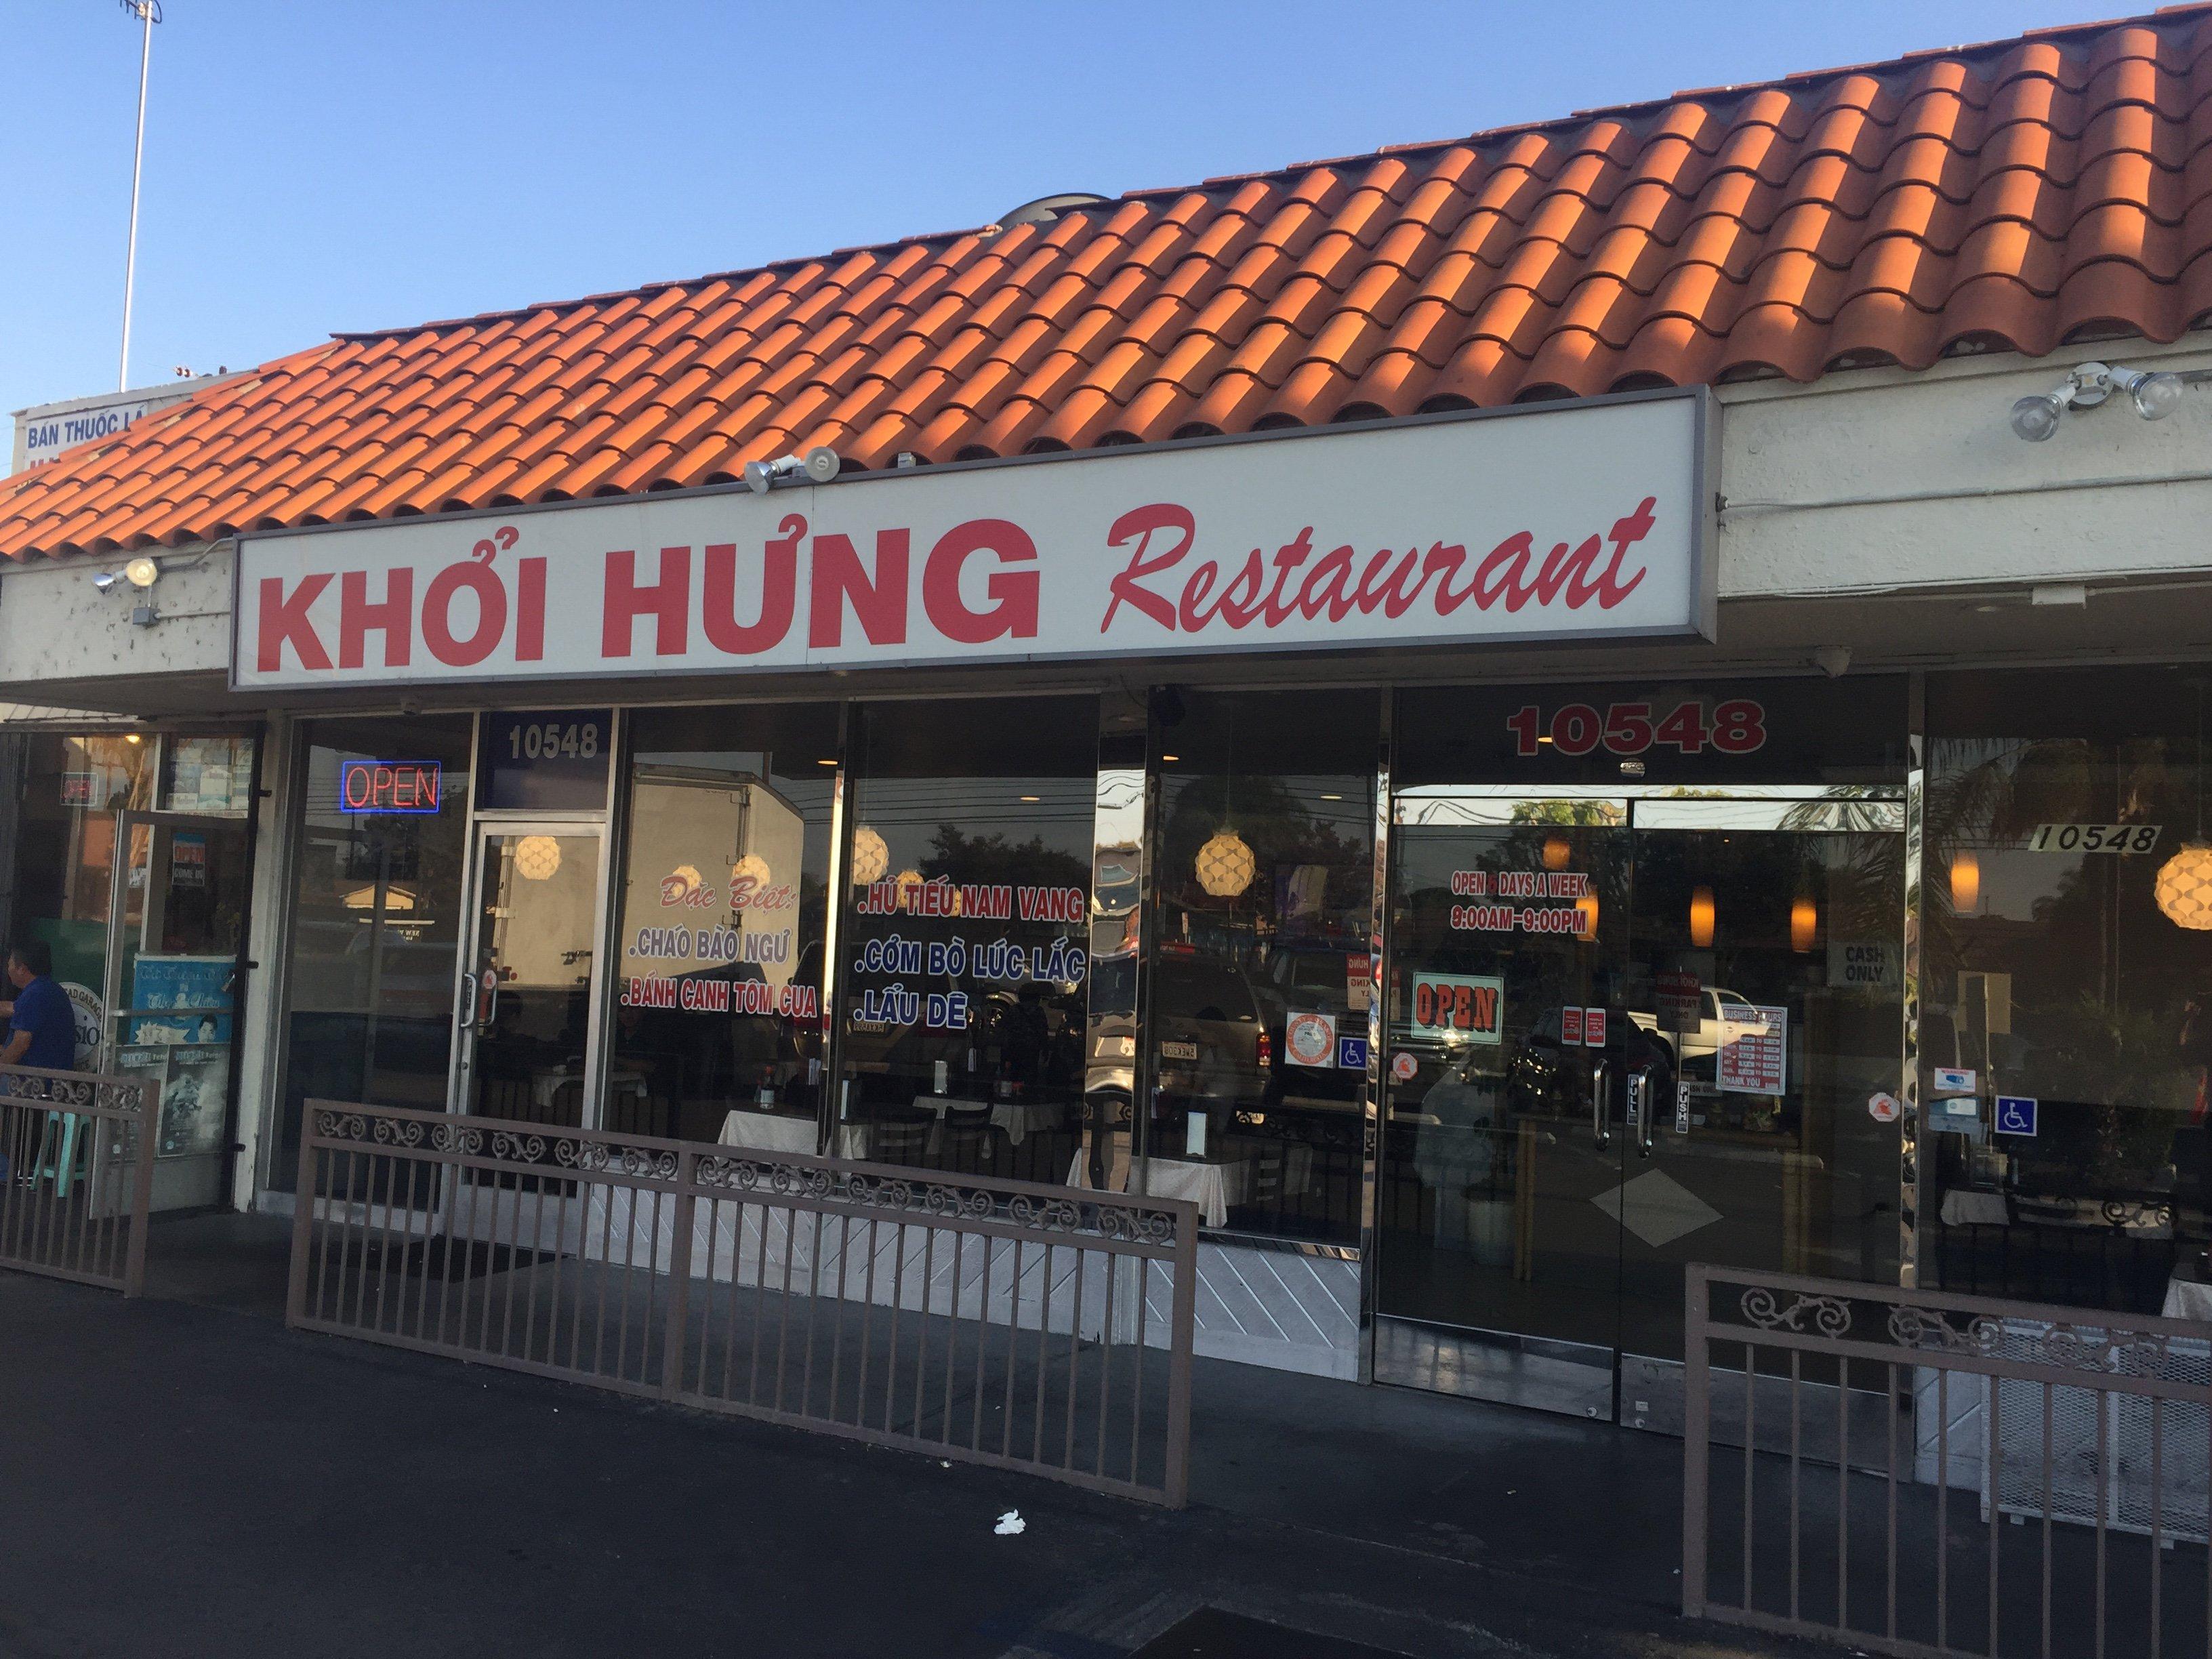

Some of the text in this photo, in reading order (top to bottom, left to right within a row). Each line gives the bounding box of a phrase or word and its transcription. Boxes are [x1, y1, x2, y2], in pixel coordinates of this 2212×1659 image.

[258, 496, 1657, 672] KHỞI HƯNG Restaurant
[509, 723, 598, 759] 10548
[1507, 699, 1767, 756] 10548
[346, 766, 438, 808] OPEN
[2038, 825, 2156, 853] 10548
[1451, 869, 1487, 896] OPEN
[1498, 870, 1535, 898] DAYS
[1535, 872, 1548, 898] A
[1548, 872, 1589, 899] WEEK
[960, 884, 1012, 920] NAM
[1017, 885, 1085, 924] VANG
[695, 924, 740, 962] BÀO
[928, 935, 967, 977] BÒ
[972, 937, 1025, 980] LÚC
[1845, 945, 1885, 962] CASH
[1845, 964, 1883, 982] ONLY
[680, 977, 730, 1012] CANH
[733, 979, 775, 1015] TÔM
[778, 985, 818, 1019] CUA
[926, 991, 968, 1029] DÊ
[1416, 983, 1499, 1033] OPEN
[1724, 1009, 1758, 1021] BUSINESS
[1629, 1079, 1638, 1113] PULL
[1722, 1075, 1745, 1086] THANK
[1746, 1076, 1761, 1087] YOU
[1678, 1086, 1687, 1121] PUSH
